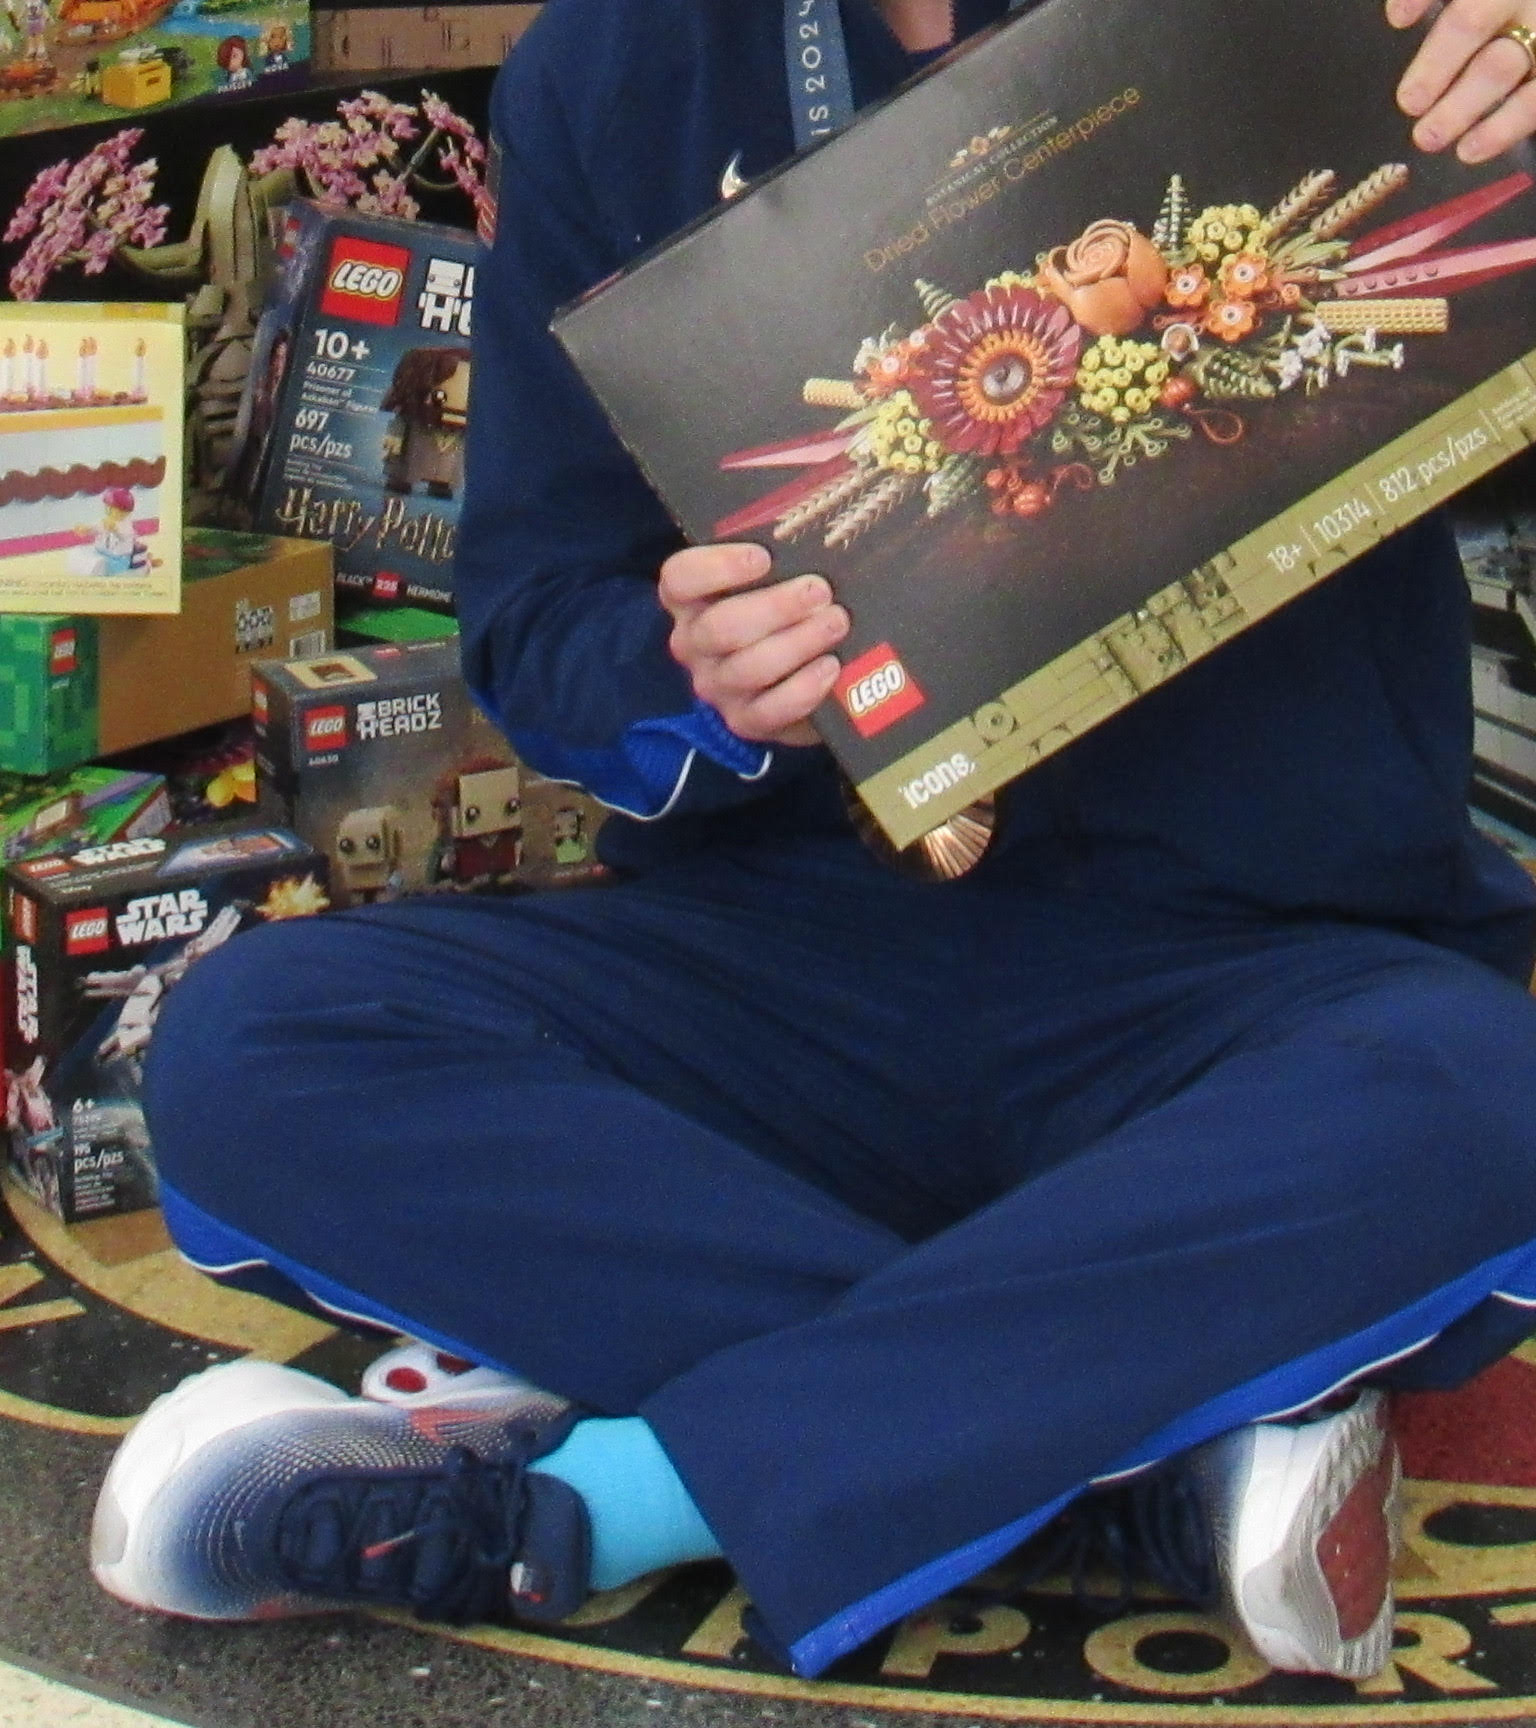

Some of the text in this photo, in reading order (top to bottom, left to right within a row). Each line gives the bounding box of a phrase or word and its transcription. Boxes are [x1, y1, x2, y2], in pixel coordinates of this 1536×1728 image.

[865, 84, 1143, 272] Dried Flower Centerpiece
[332, 260, 400, 298] LEGO
[314, 329, 370, 362] 10+
[306, 361, 356, 382] 40677
[294, 408, 330, 433] 697
[289, 433, 353, 459] pcs/pzs
[1266, 420, 1489, 576] 18+ 10314 812 pcs/pzs
[275, 486, 458, 563] Harry Potte
[405, 583, 453, 603] HERMIONE
[845, 660, 908, 714] LEGO
[378, 693, 440, 719] BRICK
[308, 716, 345, 735] LEGO
[358, 709, 443, 741] HEADZ
[900, 752, 976, 811] icons
[121, 887, 208, 920] STAR
[70, 918, 108, 940] LEGO
[115, 905, 208, 944] WARS
[74, 1152, 124, 1174] pcs/pzs
